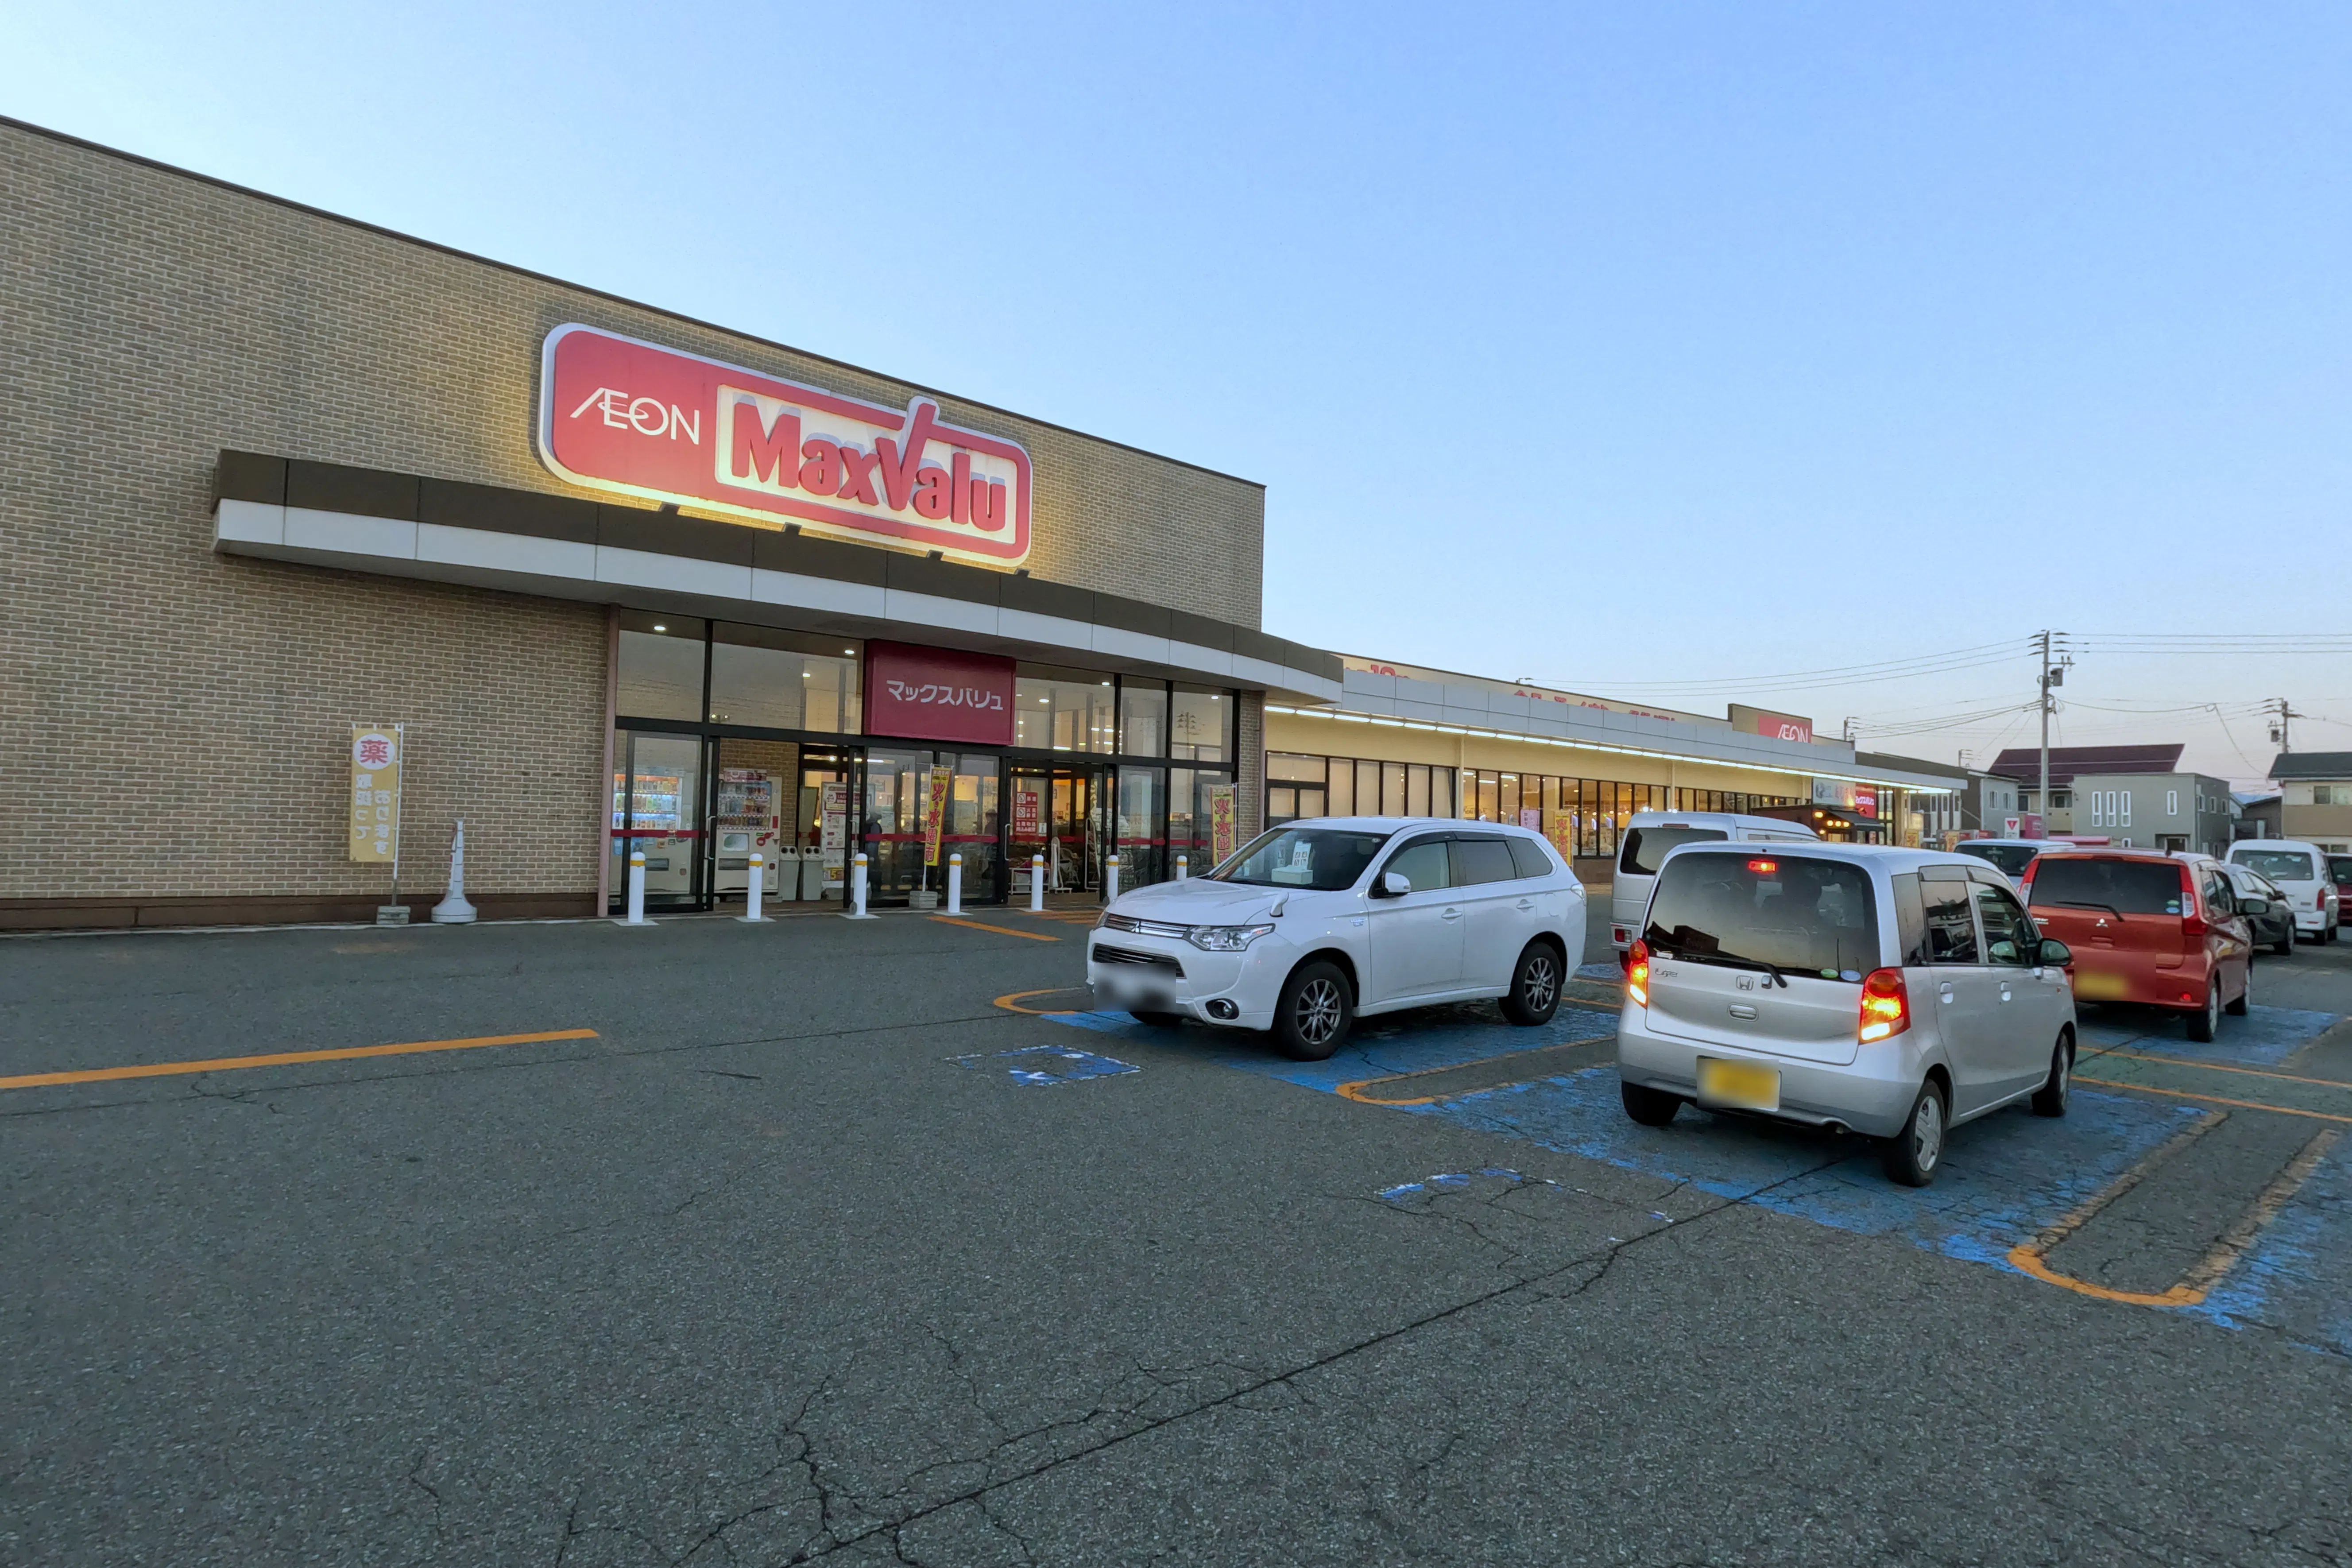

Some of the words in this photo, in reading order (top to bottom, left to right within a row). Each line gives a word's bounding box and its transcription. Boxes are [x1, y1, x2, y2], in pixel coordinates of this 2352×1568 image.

[731, 401, 1006, 532] MaxValu
[887, 680, 1003, 710] マックスバリュ
